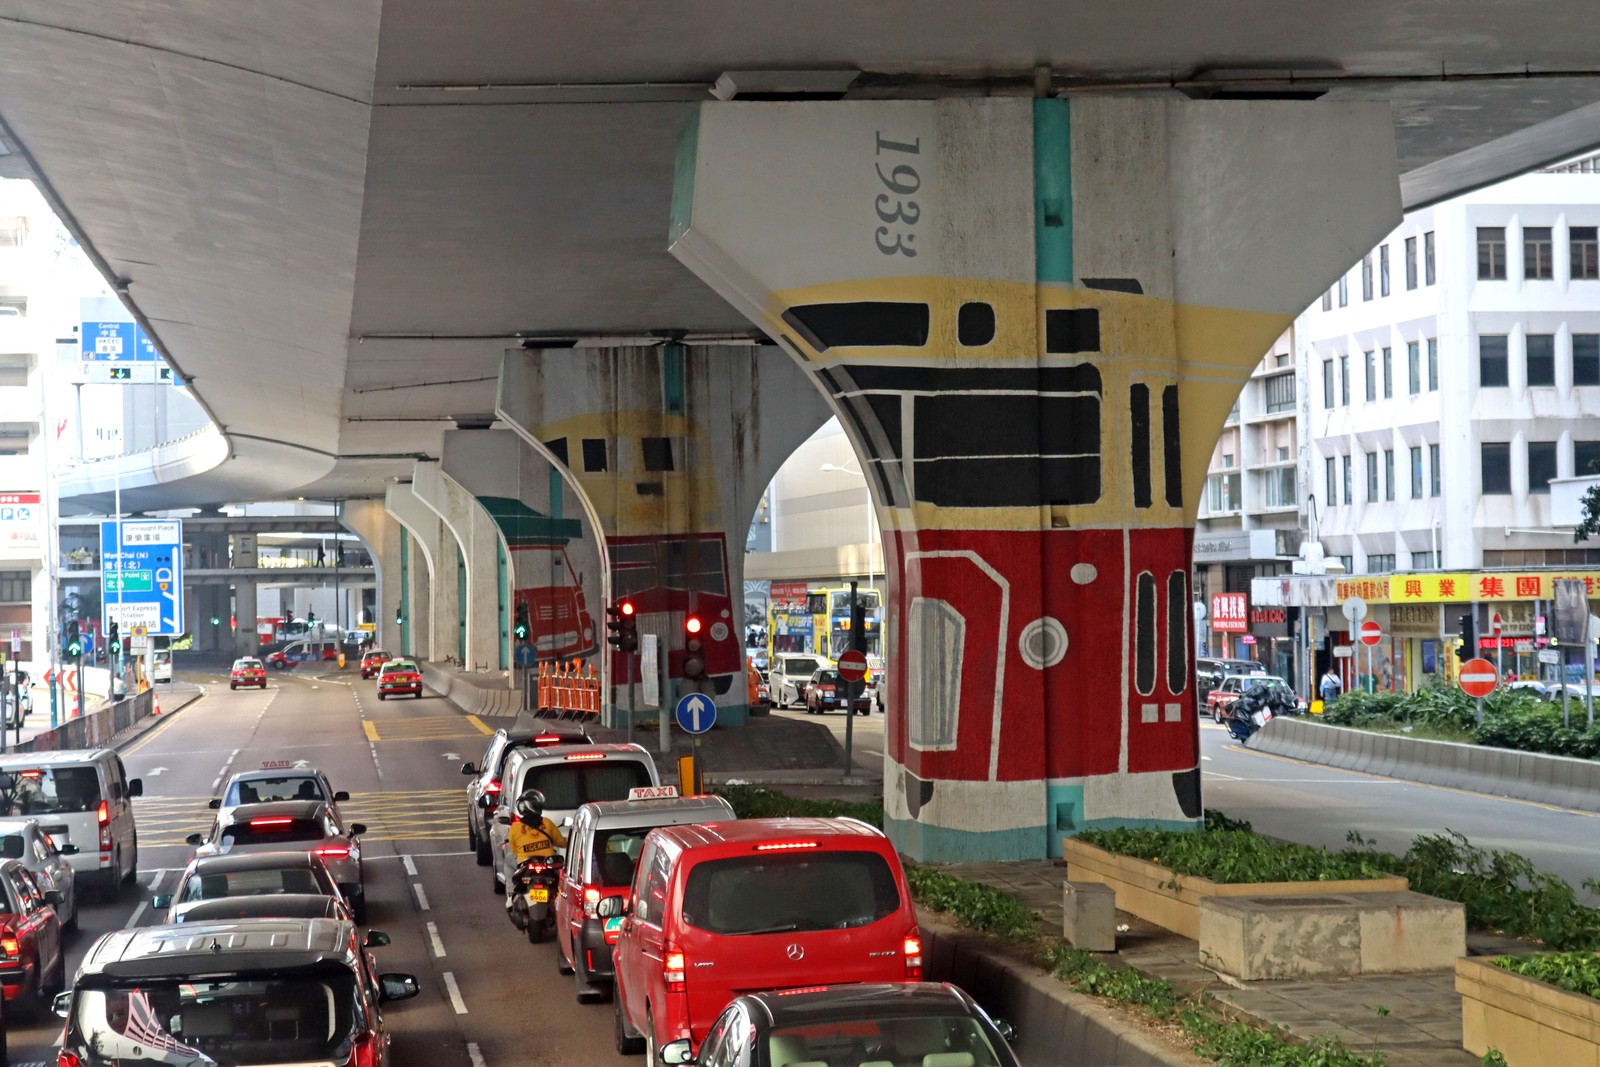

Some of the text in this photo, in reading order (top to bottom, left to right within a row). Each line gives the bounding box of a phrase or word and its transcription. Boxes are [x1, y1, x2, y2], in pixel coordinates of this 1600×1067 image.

[875, 130, 920, 258] 1933
[20, 532, 38, 541] FULL
[634, 786, 674, 798] TAXI
